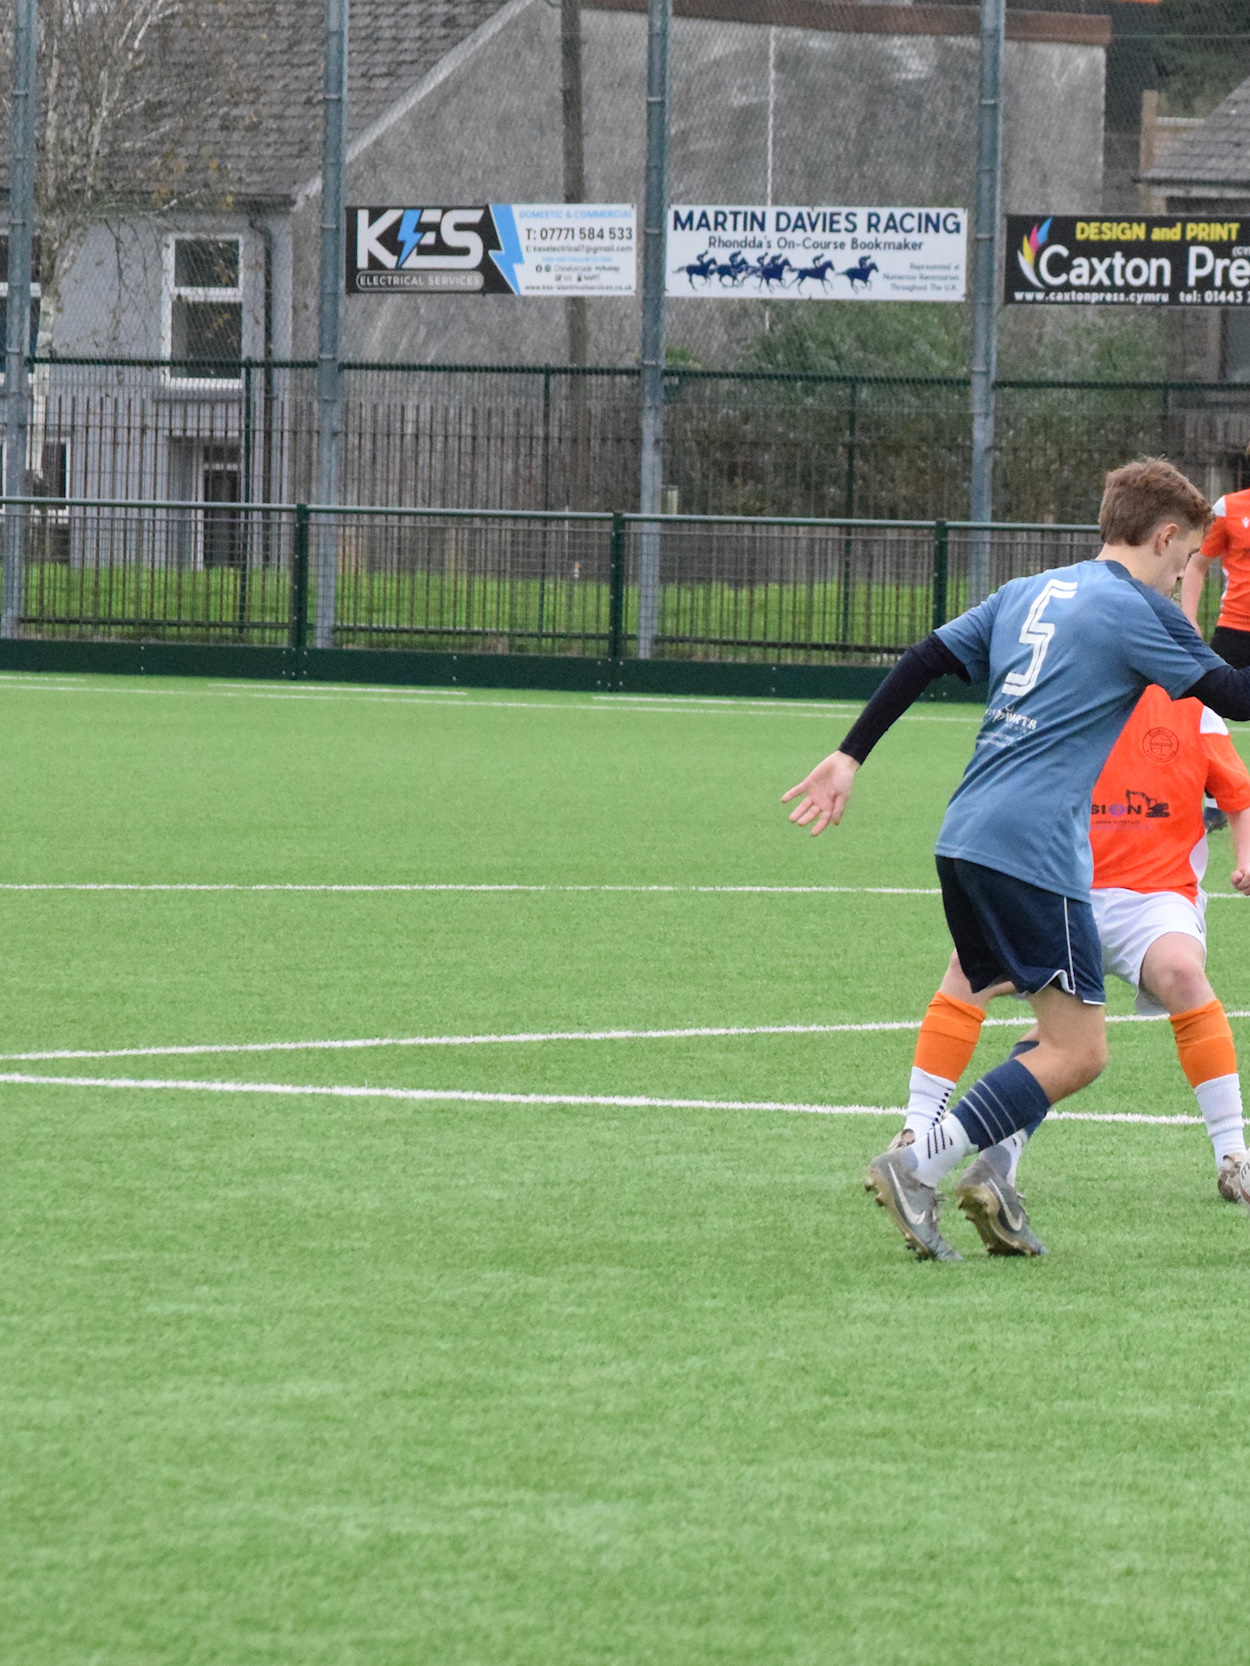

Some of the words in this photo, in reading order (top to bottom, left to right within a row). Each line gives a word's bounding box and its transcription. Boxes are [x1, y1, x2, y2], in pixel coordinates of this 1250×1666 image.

[520, 209, 563, 219] DOMESTIC
[565, 209, 572, 219] &
[574, 209, 632, 219] COMMERCIAL
[673, 210, 766, 232] MARTIN
[775, 211, 857, 233] DAVIES
[867, 212, 961, 233] RACING
[356, 208, 484, 269] KES
[525, 228, 537, 240] T:
[540, 227, 575, 240] 07771
[579, 227, 604, 240] 584
[609, 227, 633, 240] 533
[1075, 222, 1146, 241] DESIGN
[1151, 222, 1181, 241] and
[1185, 223, 1240, 241] PRINT
[708, 235, 772, 249] Rhondda's
[776, 236, 846, 250] On-Course
[851, 237, 924, 250] Bookmaker
[1039, 244, 1171, 287] Caxton
[360, 275, 425, 286] ELECTRICAL
[428, 276, 480, 286] SERVICES
[1014, 290, 1169, 304] www.caxtonpress.cymru
[1179, 290, 1201, 302] tel:
[1204, 290, 1243, 303] 01443
[1002, 579, 1078, 697] 5
